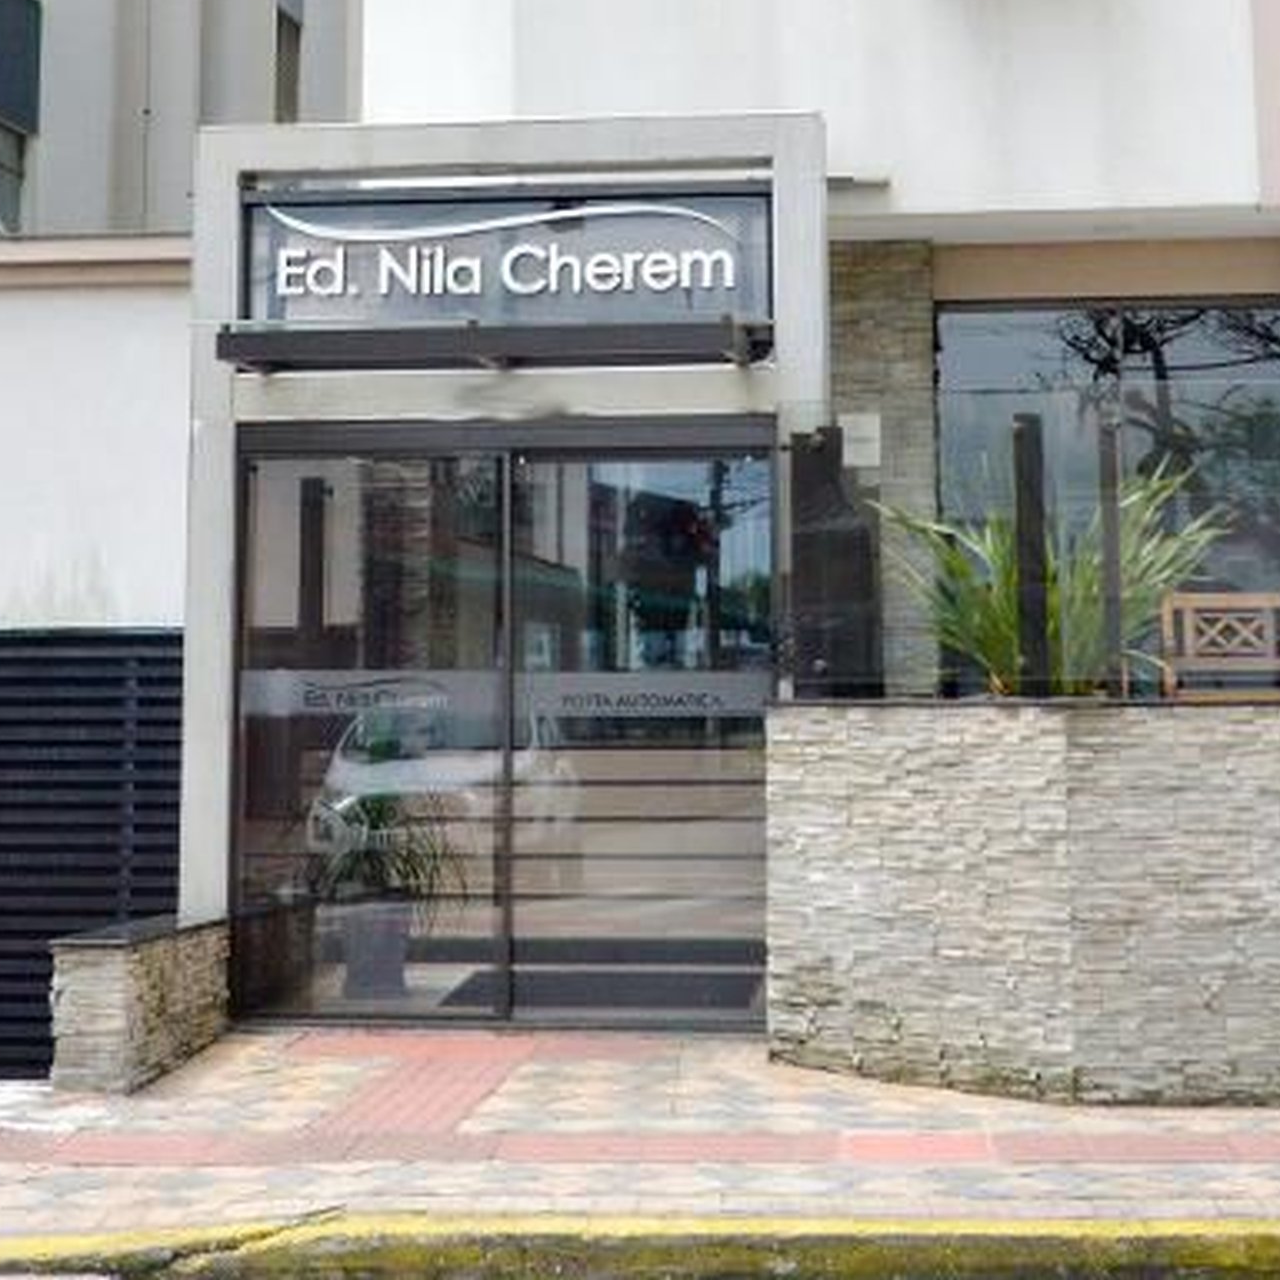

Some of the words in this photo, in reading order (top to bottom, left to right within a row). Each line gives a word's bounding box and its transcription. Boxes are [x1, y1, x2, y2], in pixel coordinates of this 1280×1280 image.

[277, 247, 358, 296] Ed.
[379, 245, 483, 296] Nila
[501, 242, 735, 295] Cherem
